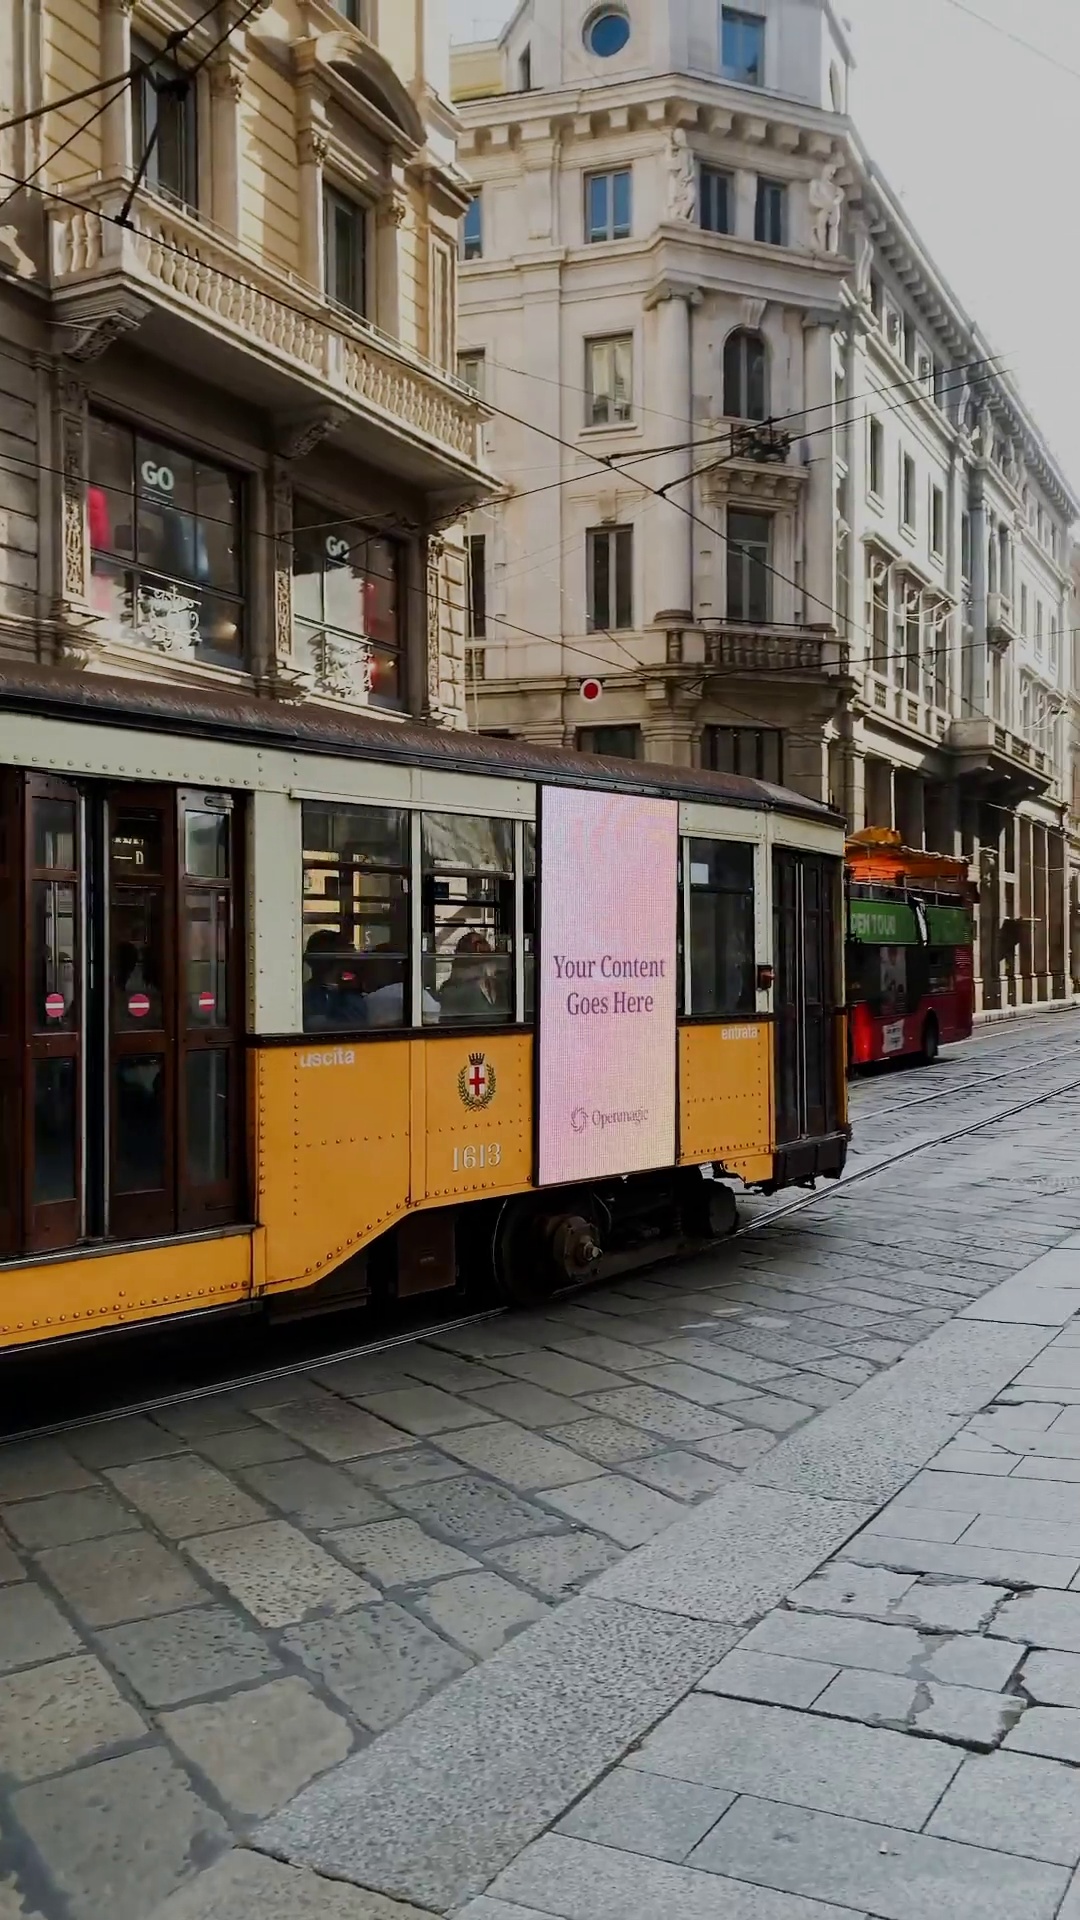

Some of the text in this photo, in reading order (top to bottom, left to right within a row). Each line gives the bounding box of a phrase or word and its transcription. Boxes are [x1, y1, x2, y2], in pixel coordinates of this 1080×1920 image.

[141, 460, 174, 491] GO
[326, 535, 350, 560] GO
[553, 954, 667, 979] Your Content
[567, 991, 654, 1015] Goes Here
[300, 1046, 355, 1068] uscita
[591, 1106, 649, 1129] Openmagic
[452, 1142, 501, 1172] 1613
